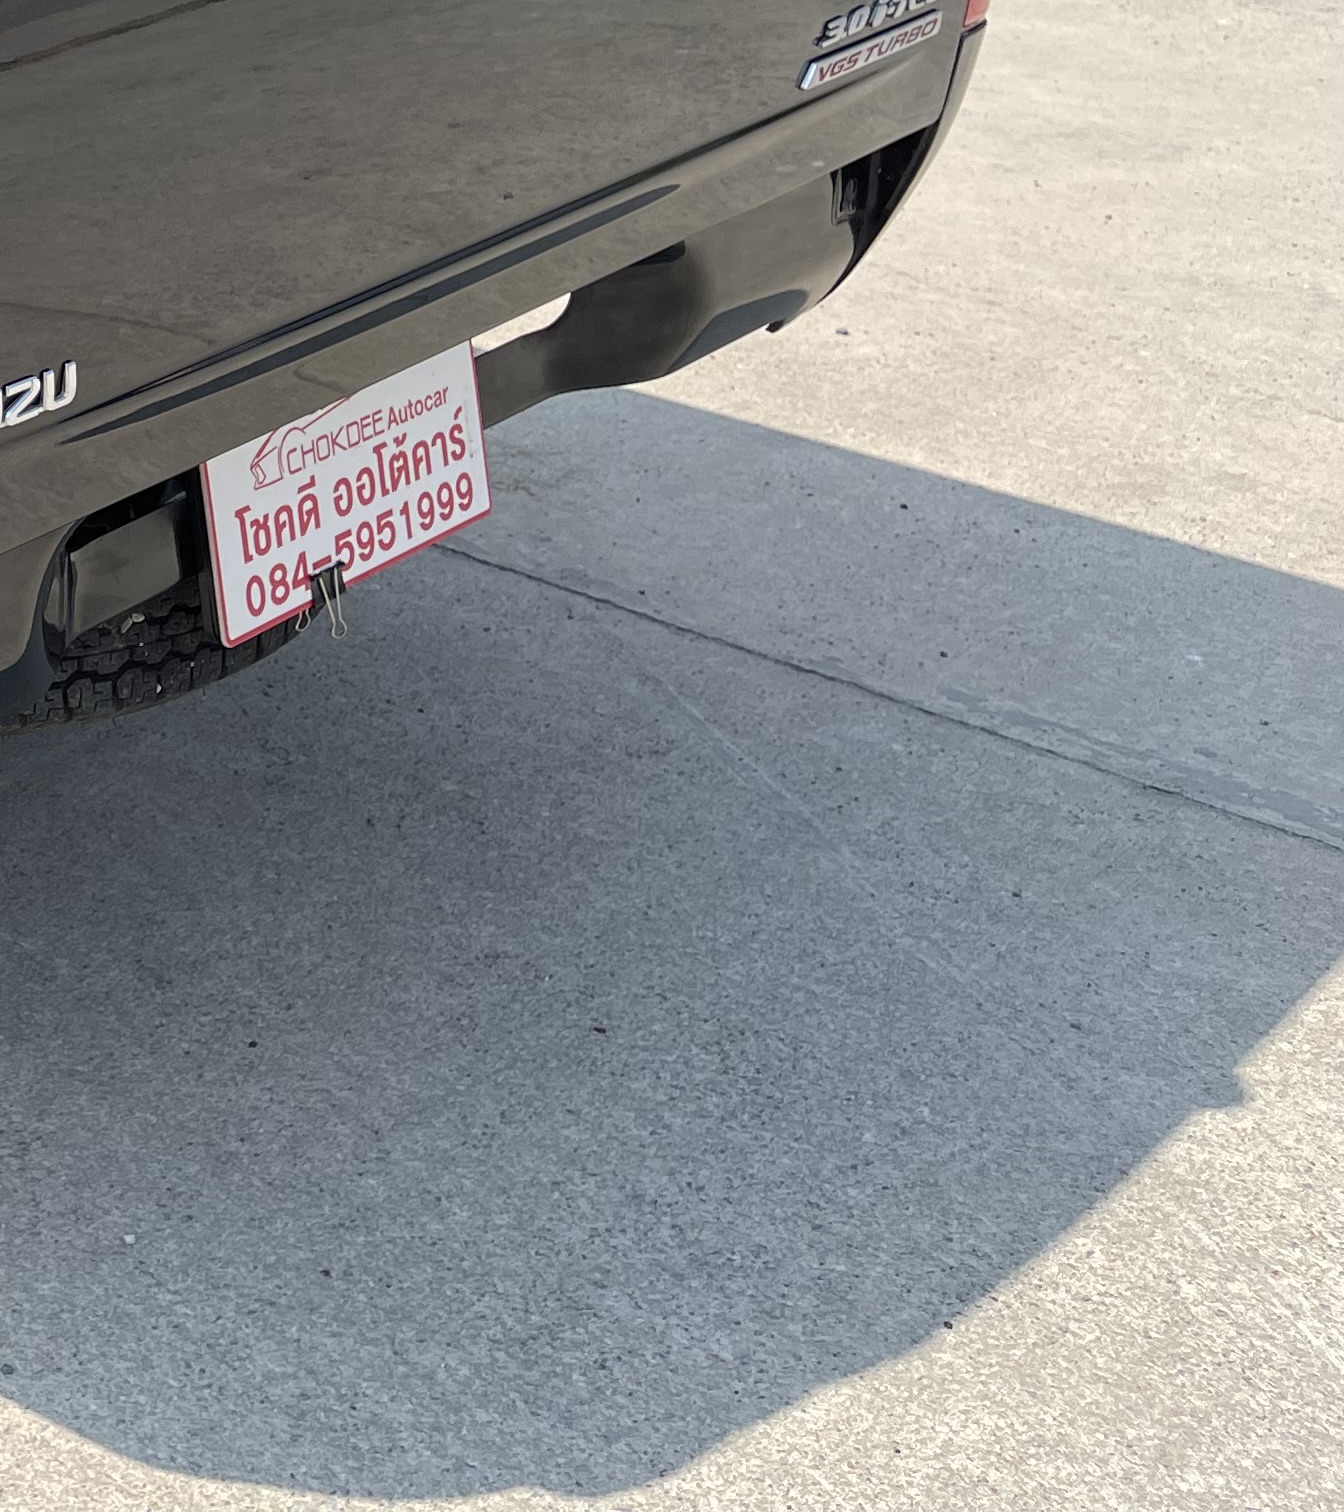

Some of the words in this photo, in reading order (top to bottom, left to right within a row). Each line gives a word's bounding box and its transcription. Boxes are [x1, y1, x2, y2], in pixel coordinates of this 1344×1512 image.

[818, 49, 862, 82] VGS
[863, 18, 939, 63] TURBO
[234, 474, 322, 565] โชคดี
[333, 405, 468, 518] ออโต้คาร์
[286, 409, 386, 476] CHOKDEE
[387, 386, 449, 431] Autocar
[245, 472, 474, 617] 084-5951999
